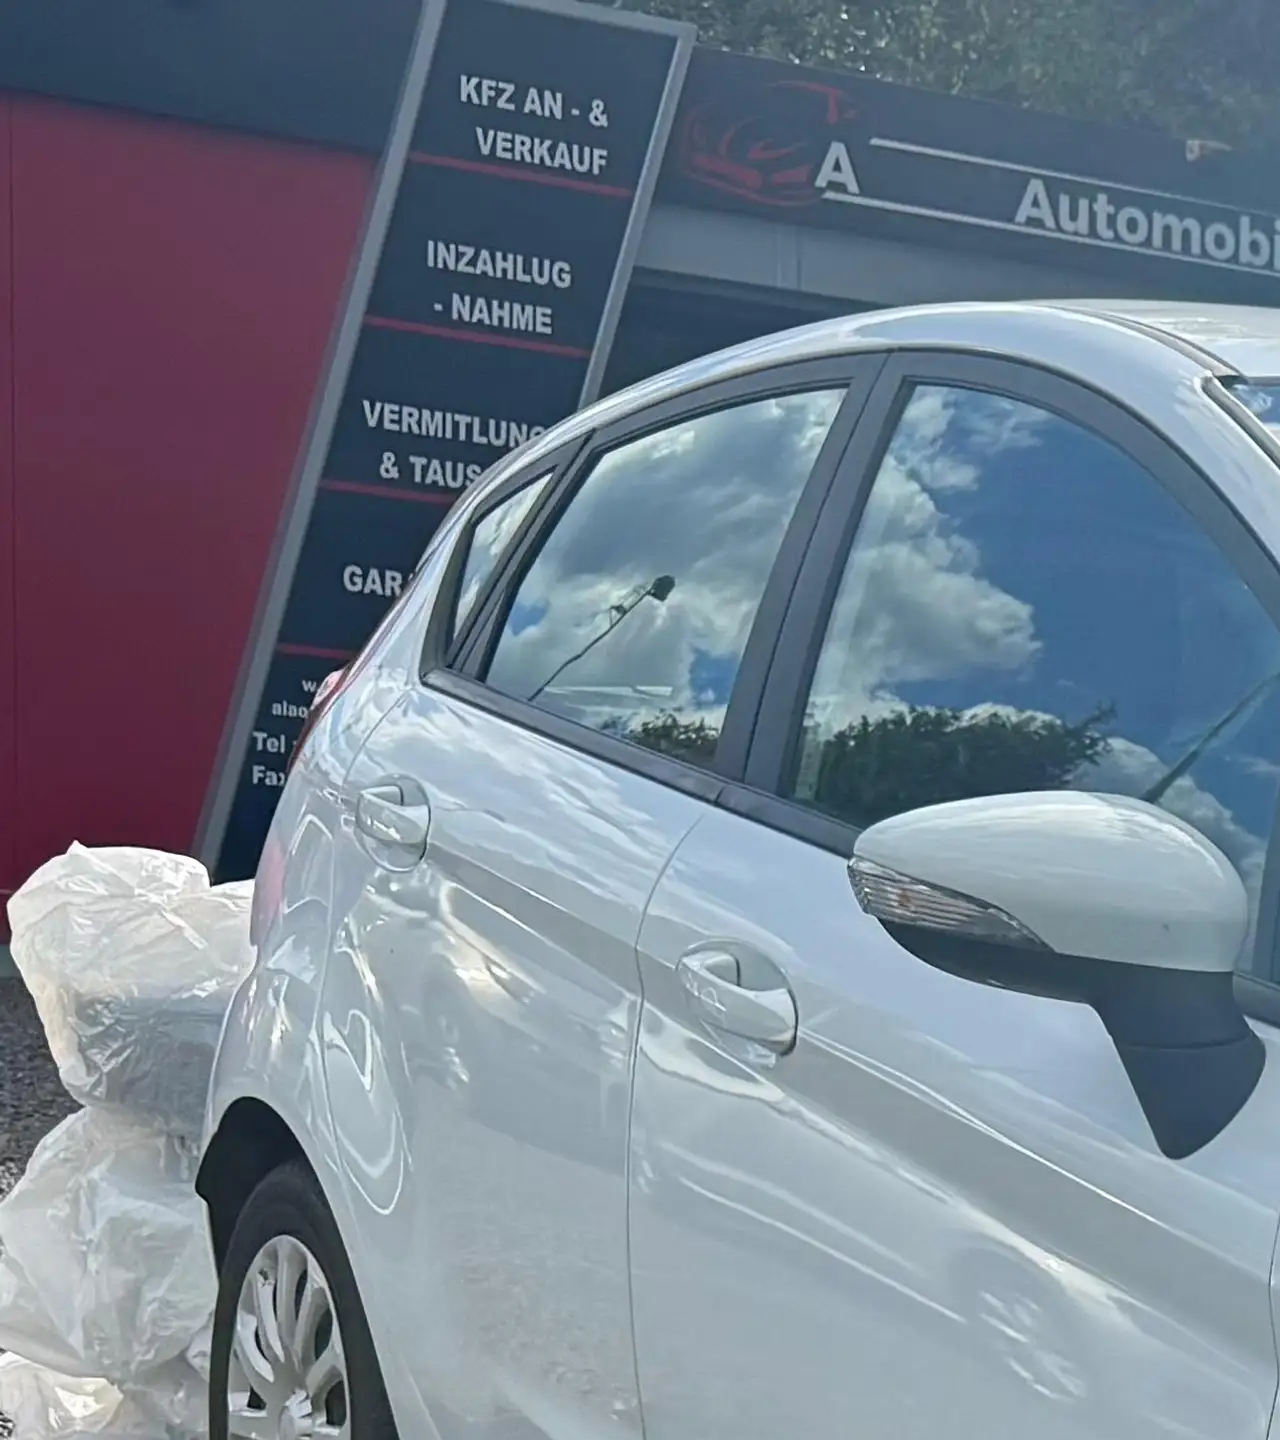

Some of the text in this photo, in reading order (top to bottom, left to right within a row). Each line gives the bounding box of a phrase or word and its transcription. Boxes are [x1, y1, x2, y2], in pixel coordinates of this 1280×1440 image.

[460, 74, 516, 111] KFZ
[523, 87, 562, 120] AN
[588, 98, 609, 128] &
[475, 126, 608, 175] VERKAUF
[815, 140, 860, 195] A
[427, 240, 572, 288] INZAHLUG
[452, 292, 552, 335] NAHME
[379, 451, 399, 480] &
[343, 563, 413, 597] GAR
[252, 731, 286, 754] Tel
